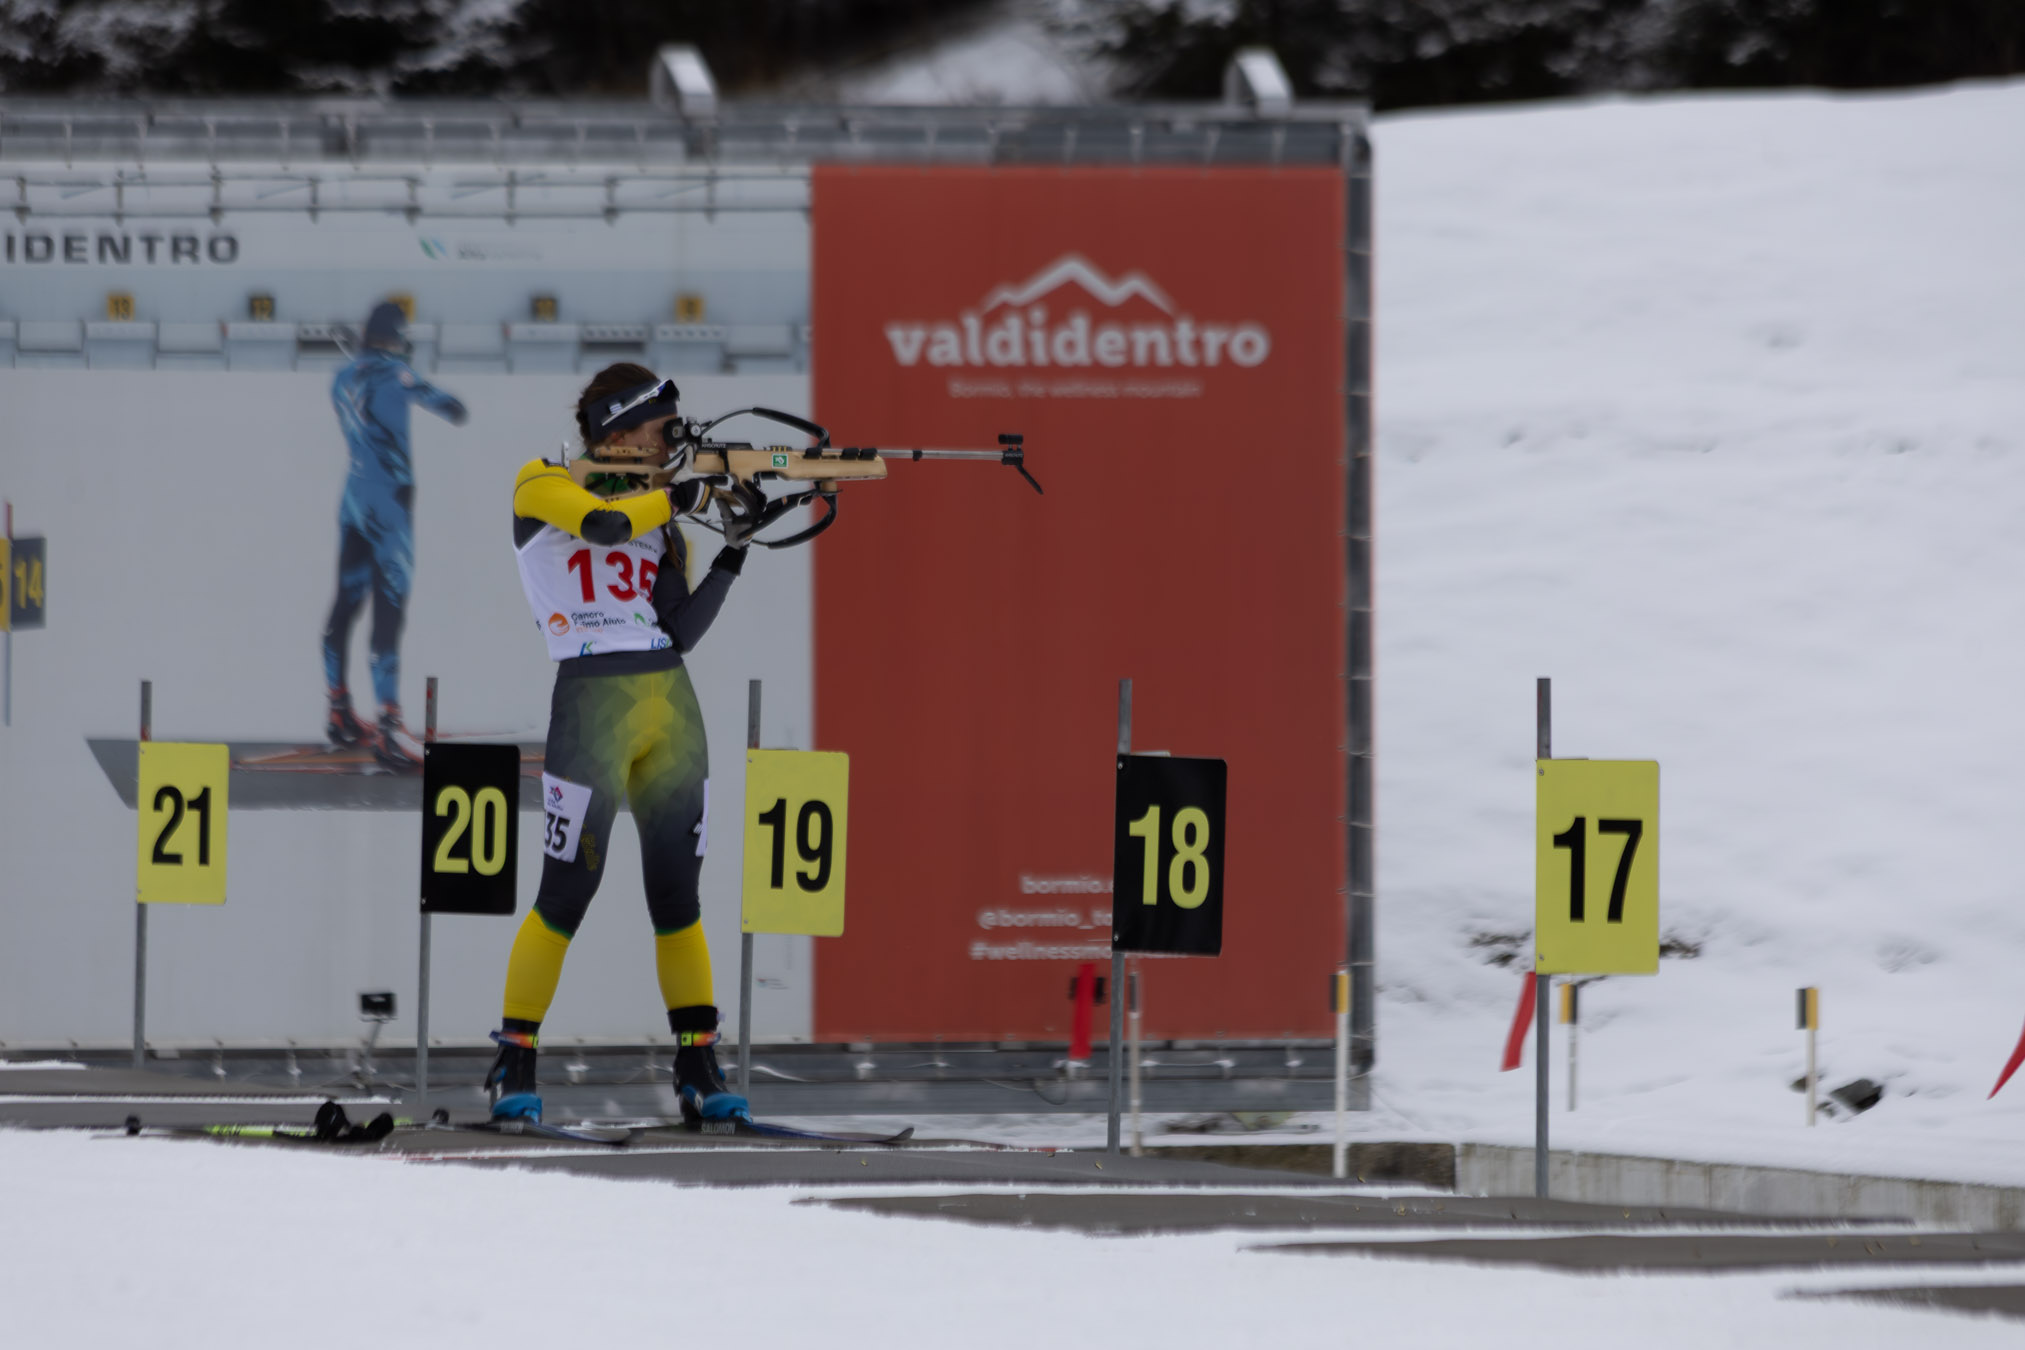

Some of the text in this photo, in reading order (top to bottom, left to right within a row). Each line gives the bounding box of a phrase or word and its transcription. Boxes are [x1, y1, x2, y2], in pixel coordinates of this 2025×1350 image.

[885, 308, 1271, 366] valdidentro
[13, 558, 44, 609] 14
[567, 548, 658, 603] 135
[152, 786, 210, 865] 21
[433, 785, 508, 876] 20
[758, 798, 834, 892] 19
[1128, 805, 1210, 909] 18
[1554, 816, 1643, 923] 17
[701, 1122, 736, 1135] SALOMON
